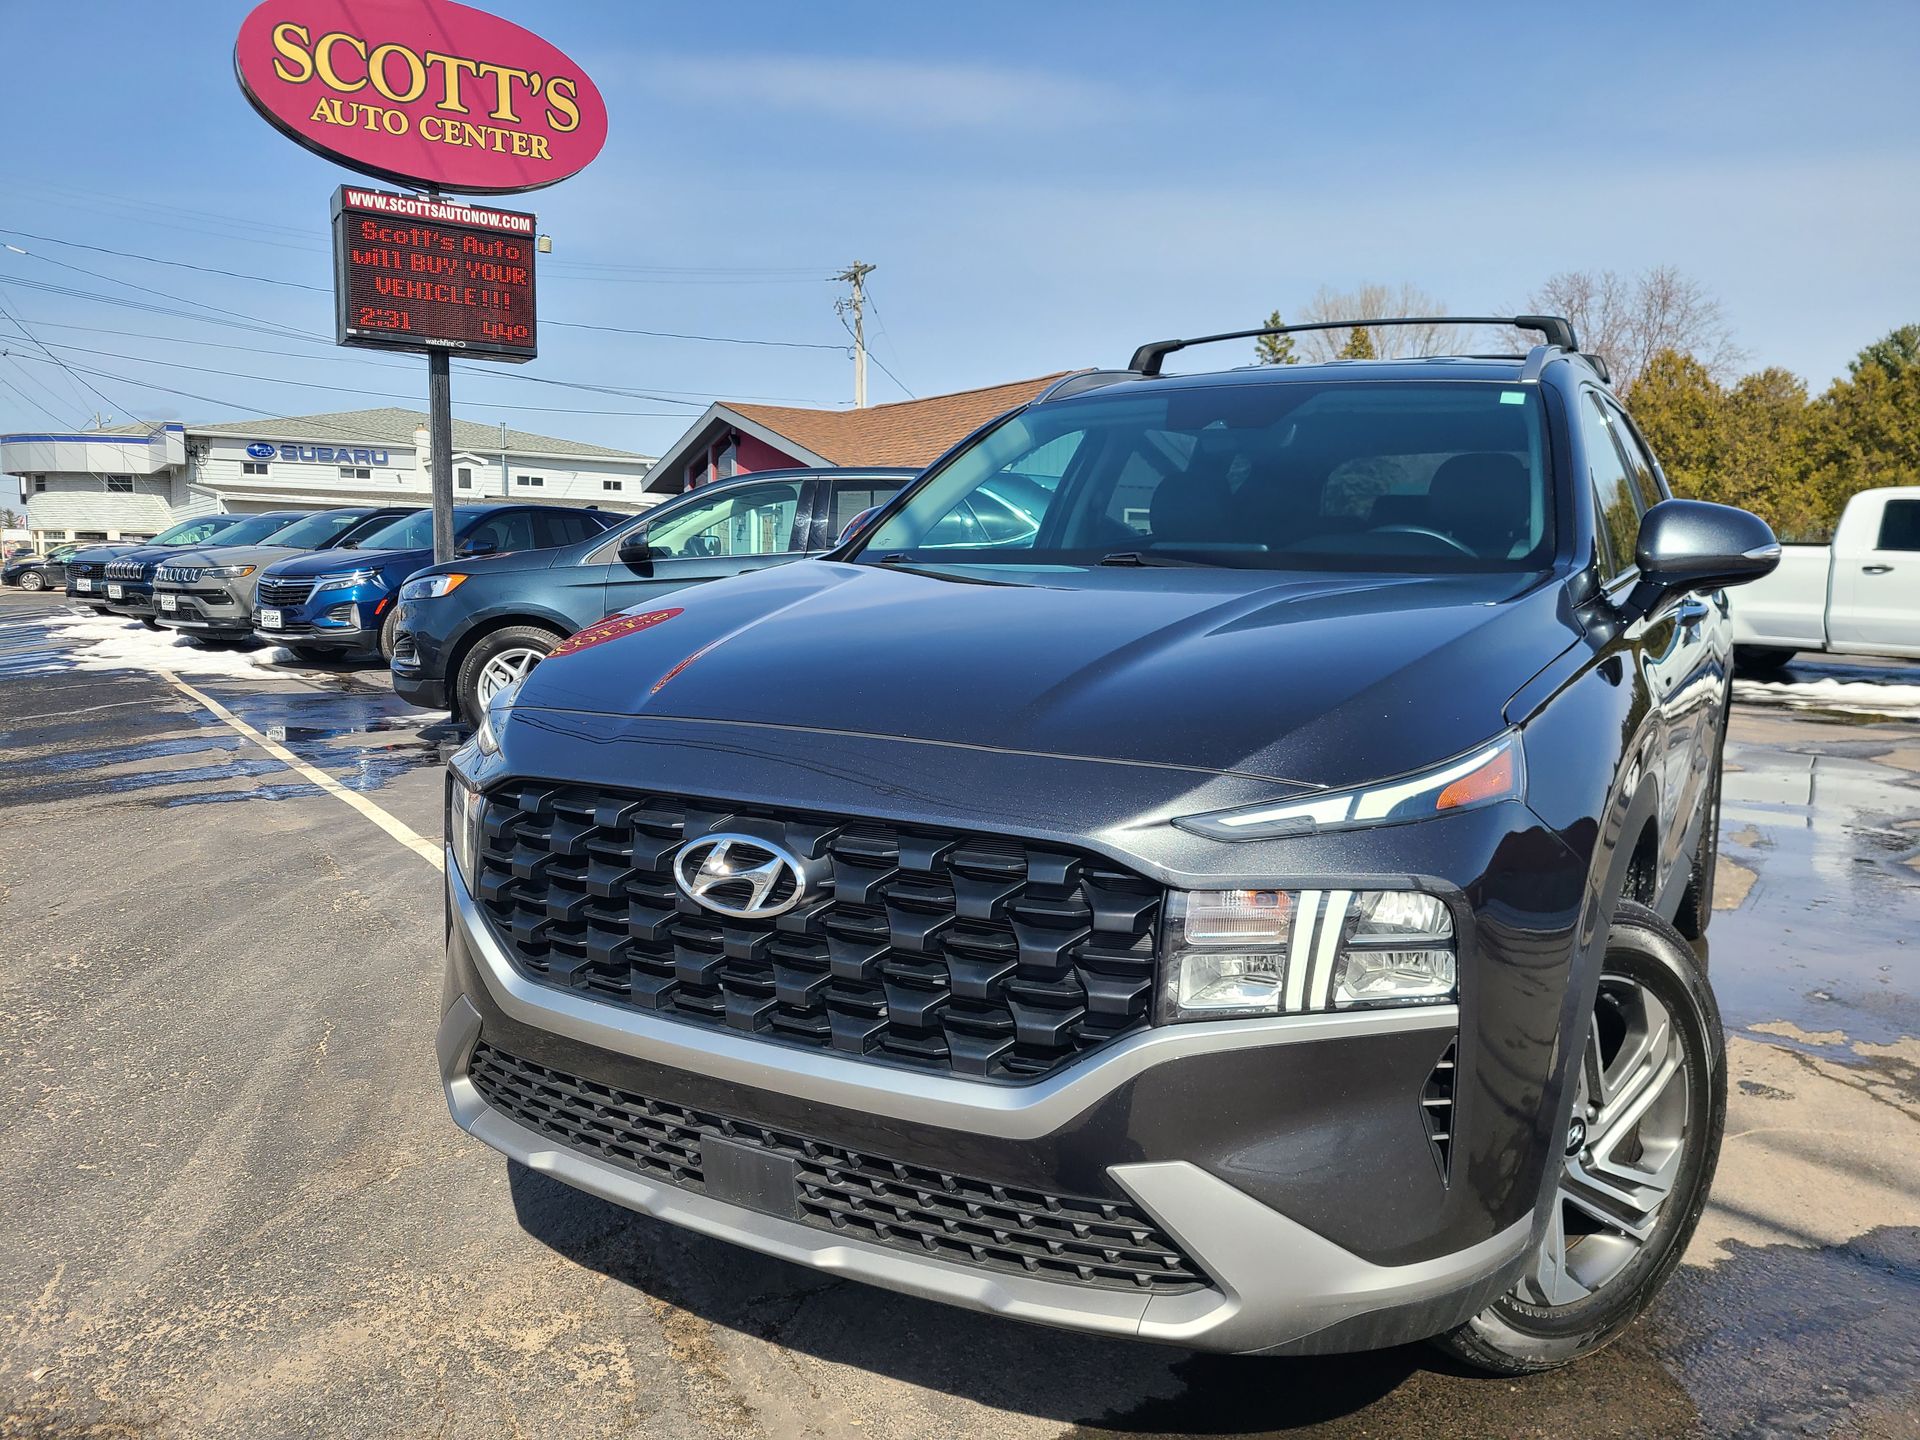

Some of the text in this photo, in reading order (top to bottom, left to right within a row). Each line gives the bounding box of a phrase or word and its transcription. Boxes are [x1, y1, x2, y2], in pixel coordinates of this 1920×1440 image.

[271, 22, 581, 132] SCOTT'S
[310, 97, 552, 160] AUTO CENTER
[348, 191, 530, 231] WWW.SCOTTSAUTONOW.COM
[361, 221, 519, 260] Scott's Auto
[352, 248, 527, 285] will BUY YOUR
[374, 276, 510, 309] VEHICLE!!!
[360, 307, 411, 329] 2:31
[280, 445, 389, 466] SUBARU
